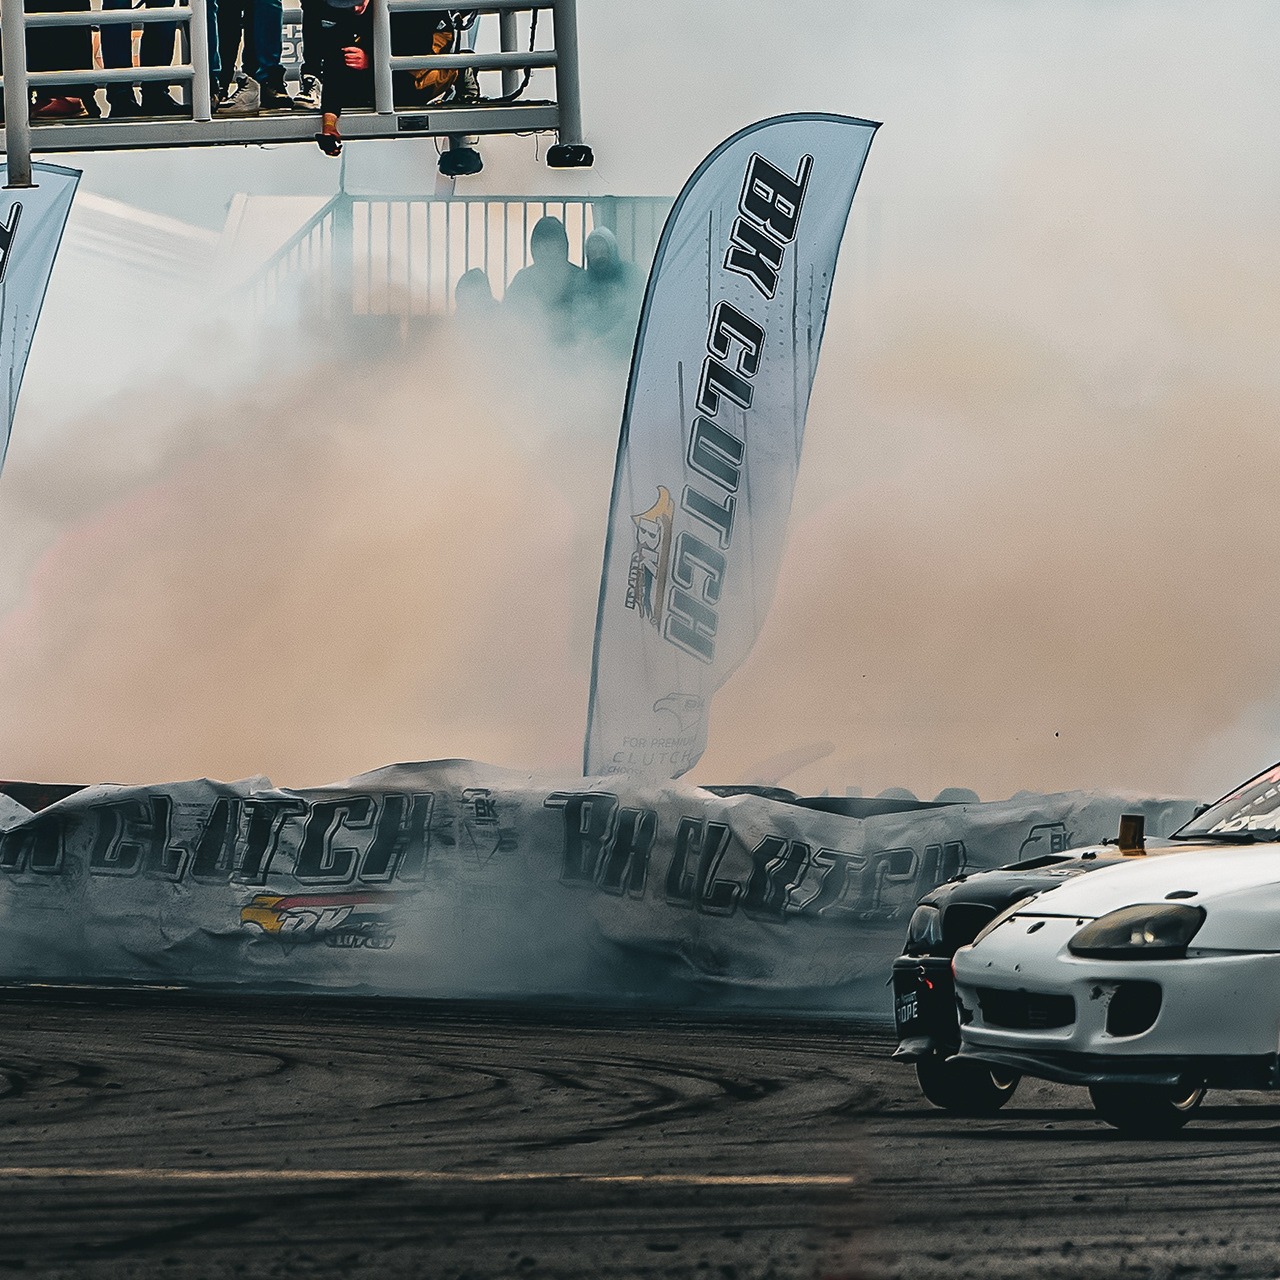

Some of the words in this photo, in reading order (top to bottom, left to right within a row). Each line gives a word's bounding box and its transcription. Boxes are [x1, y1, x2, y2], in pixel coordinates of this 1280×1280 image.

[723, 152, 815, 301] BK
[663, 299, 767, 665] CLUTCH
[612, 750, 693, 766] CLUTCH
[543, 790, 658, 900] BK
